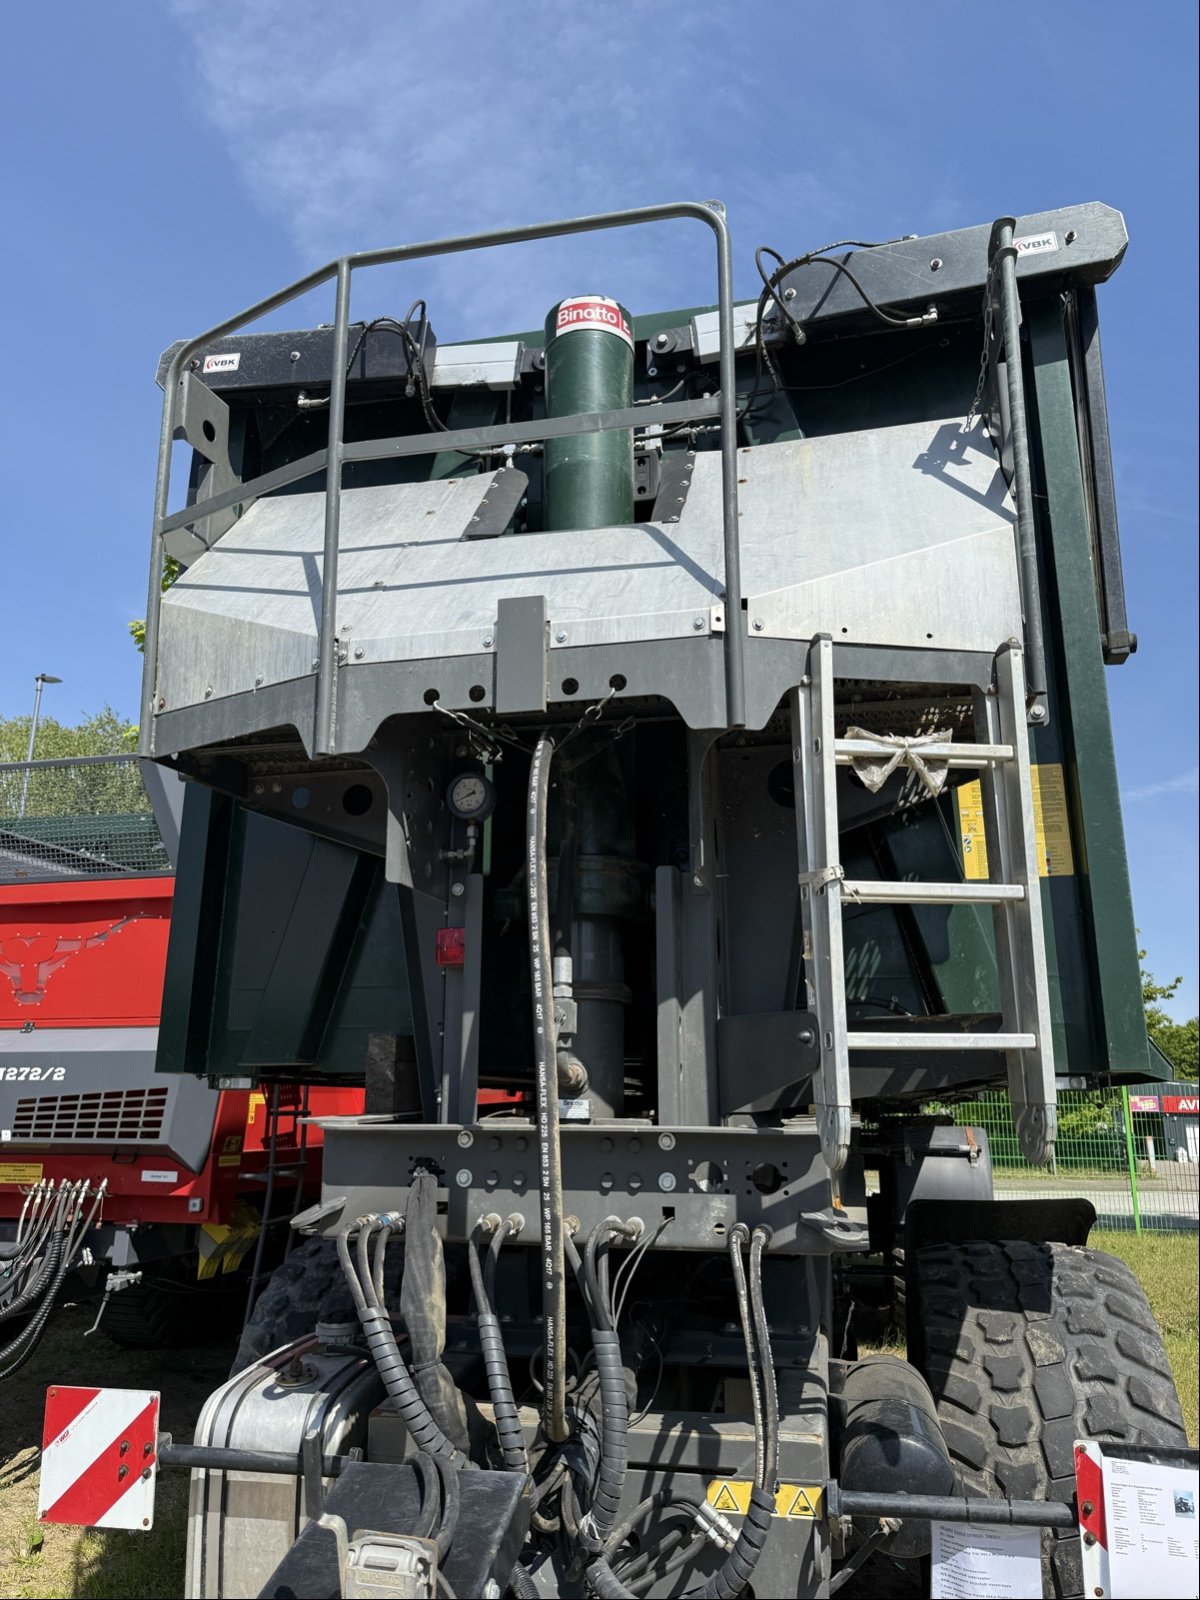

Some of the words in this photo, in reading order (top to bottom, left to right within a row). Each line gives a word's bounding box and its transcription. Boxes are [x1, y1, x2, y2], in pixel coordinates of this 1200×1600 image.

[1022, 238, 1053, 250] VBK
[557, 306, 618, 326] Binotto
[213, 359, 235, 367] VBK
[533, 957, 540, 968] WP
[538, 1061, 547, 1108] HANSA-FLEX
[541, 1112, 547, 1123] HD
[541, 1142, 549, 1153] EN
[543, 1176, 550, 1187] SN
[543, 1192, 550, 1201] 25
[544, 1207, 551, 1220] WP
[546, 1316, 554, 1357] HANSA-FLEX
